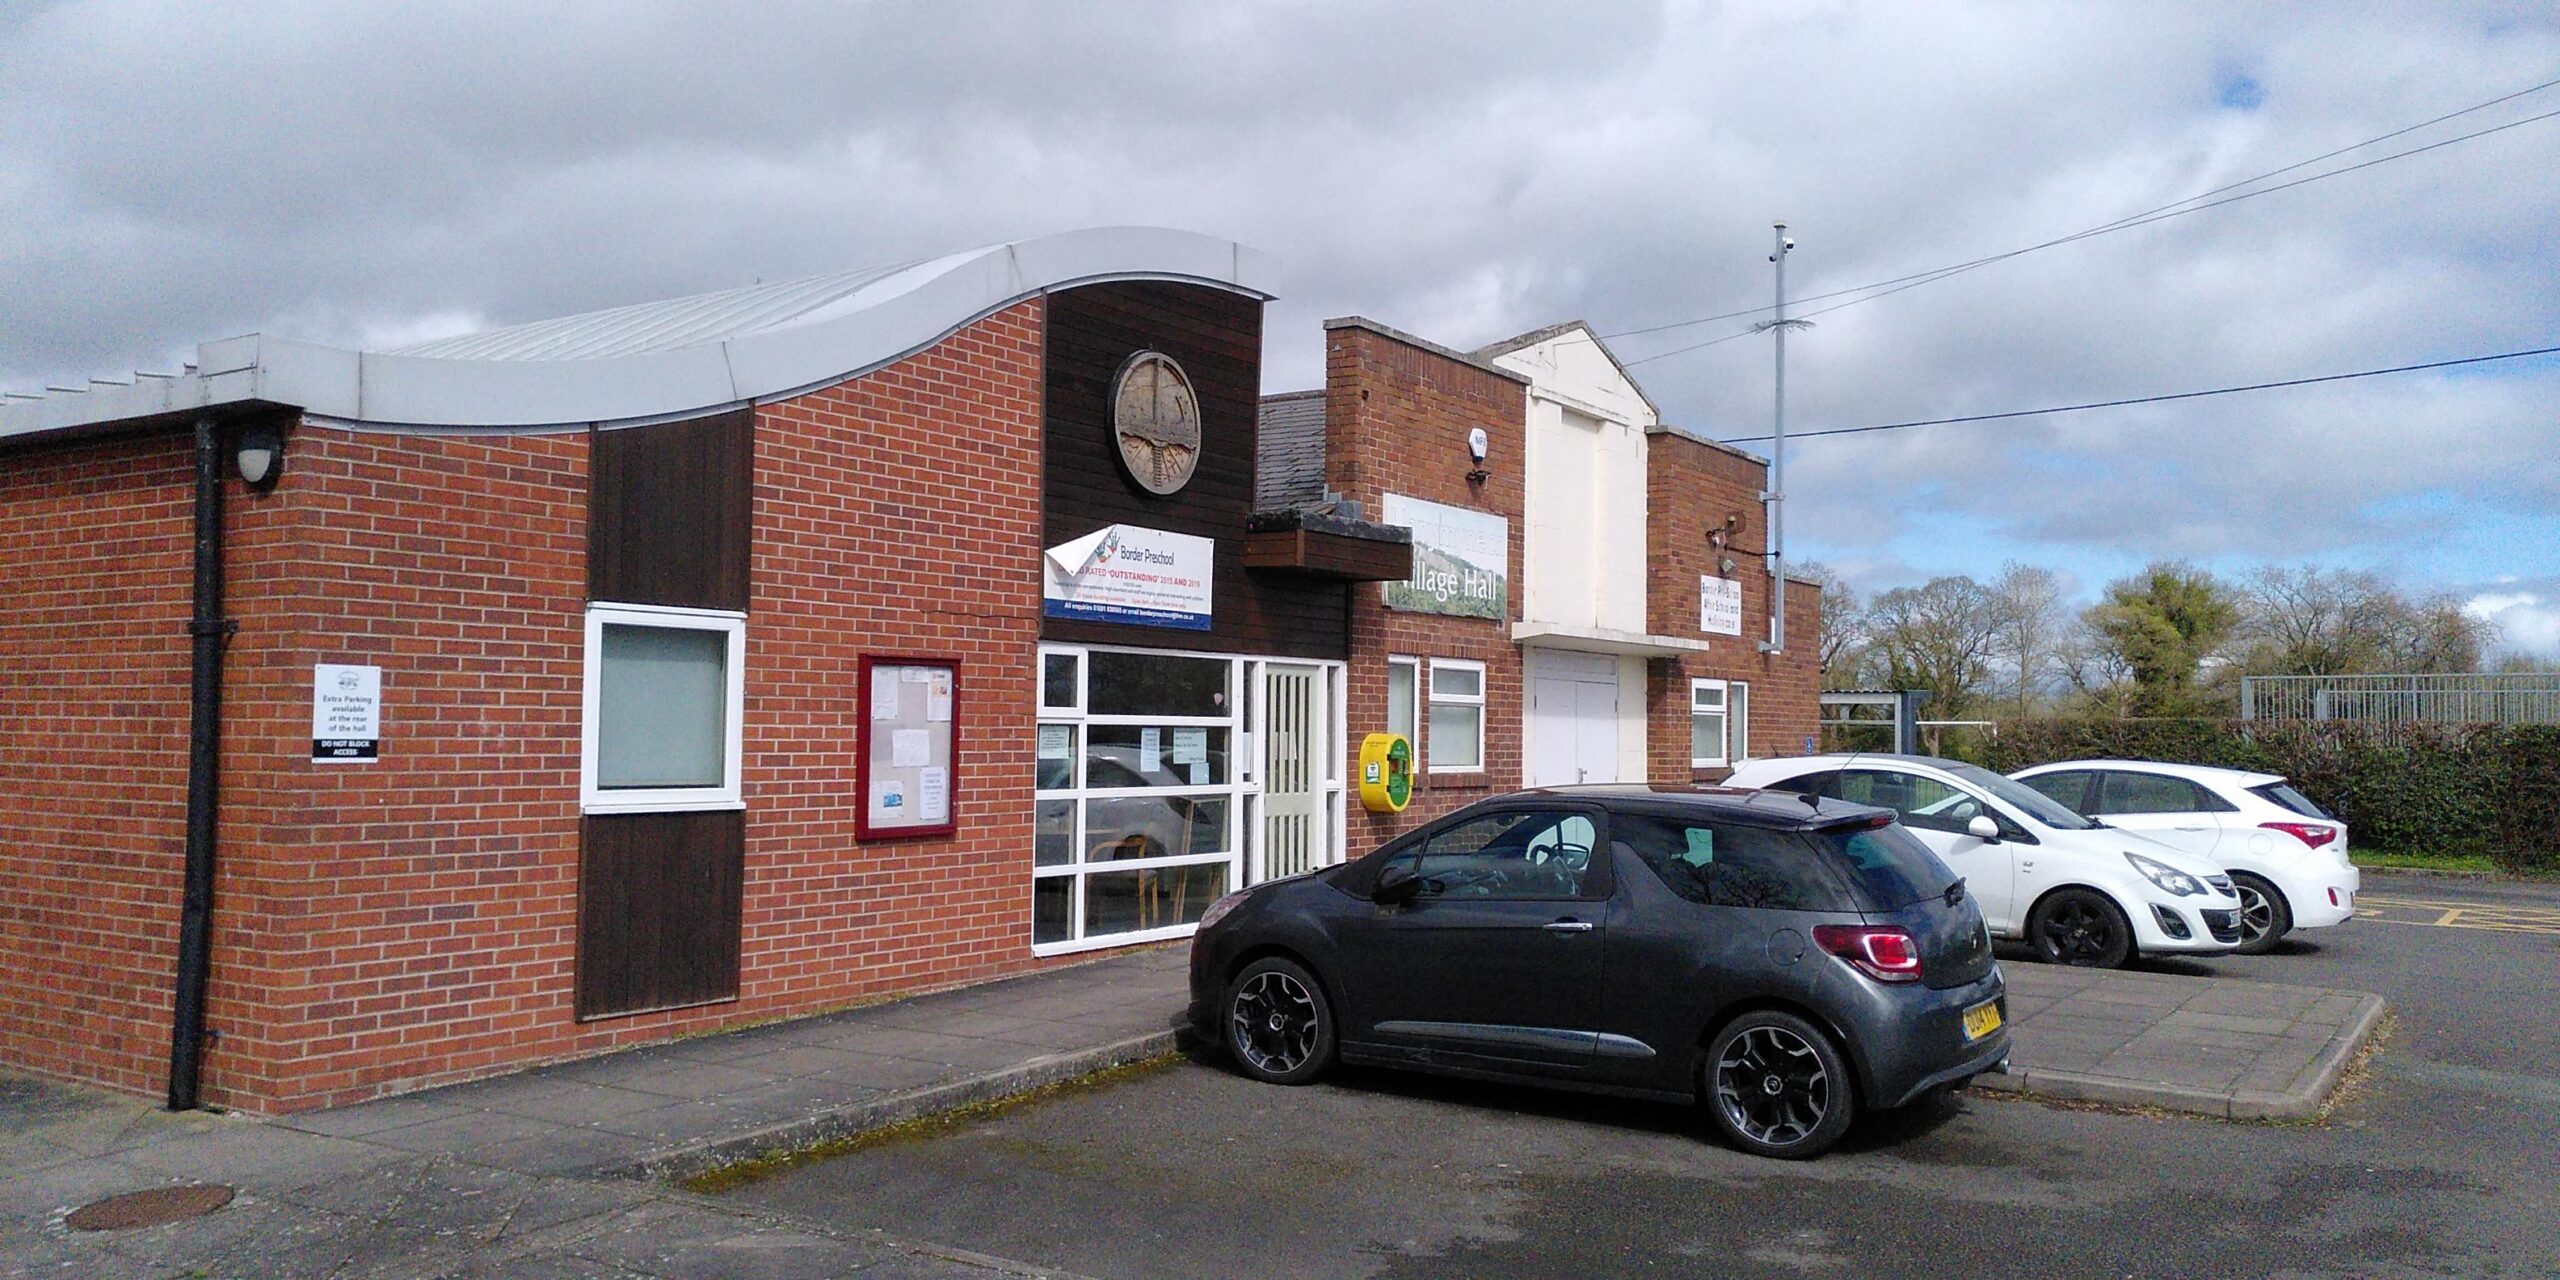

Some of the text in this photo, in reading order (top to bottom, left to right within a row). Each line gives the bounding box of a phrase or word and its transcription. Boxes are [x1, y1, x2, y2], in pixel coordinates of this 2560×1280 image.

[1120, 545, 1175, 566] Border Preschool
[1086, 567, 1107, 577] RATED
[1160, 575, 1173, 585] 2015
[1173, 577, 1188, 587] AND
[1403, 560, 1497, 602] illage Hall
[323, 695, 372, 704] Extra Parking
[332, 705, 365, 713] available
